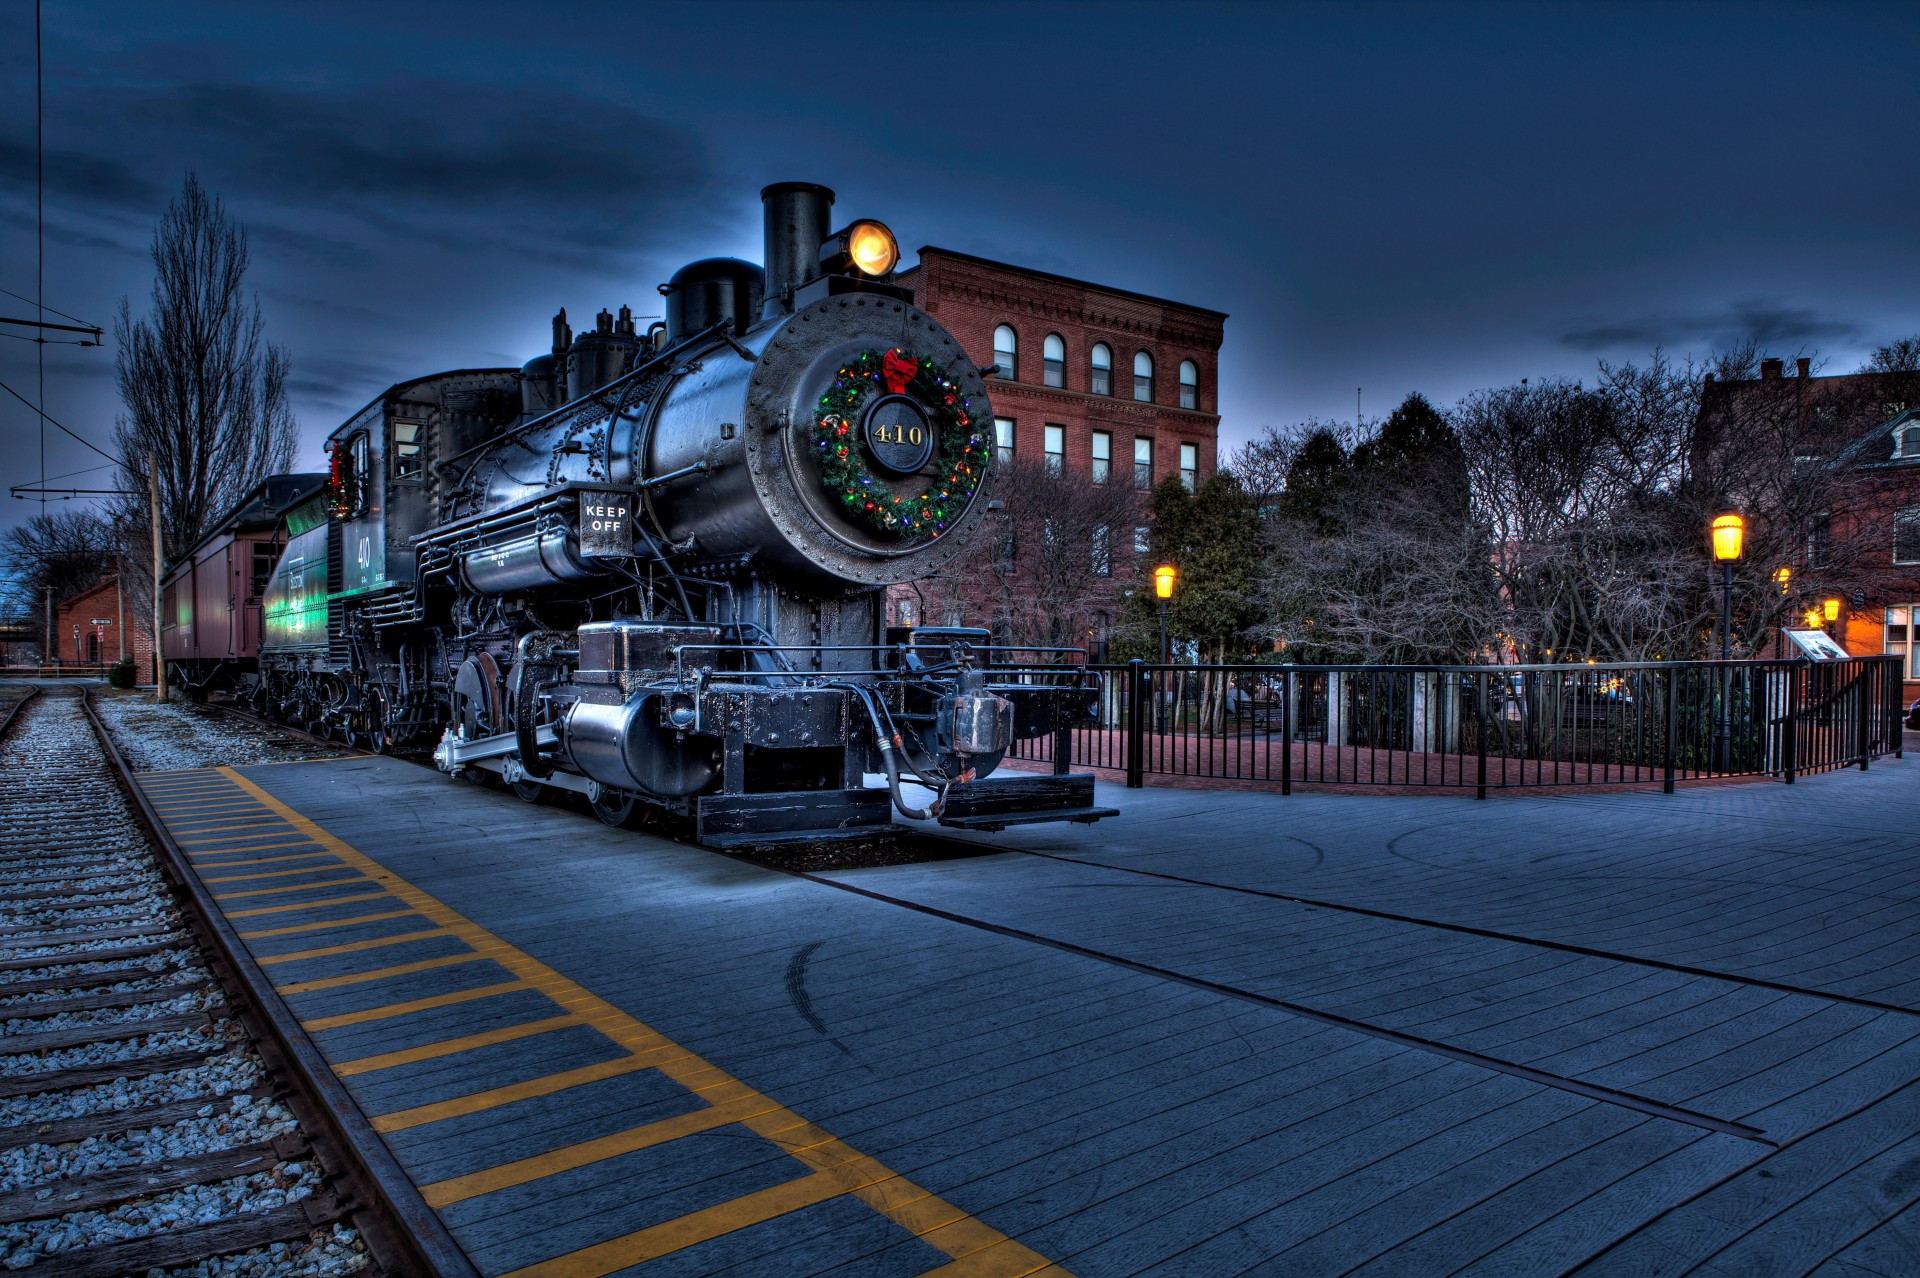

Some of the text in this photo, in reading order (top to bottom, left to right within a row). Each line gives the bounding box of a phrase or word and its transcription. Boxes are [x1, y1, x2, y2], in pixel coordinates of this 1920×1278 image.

[874, 424, 922, 445] 410
[586, 505, 626, 518] KEEP
[592, 520, 621, 532] OFF
